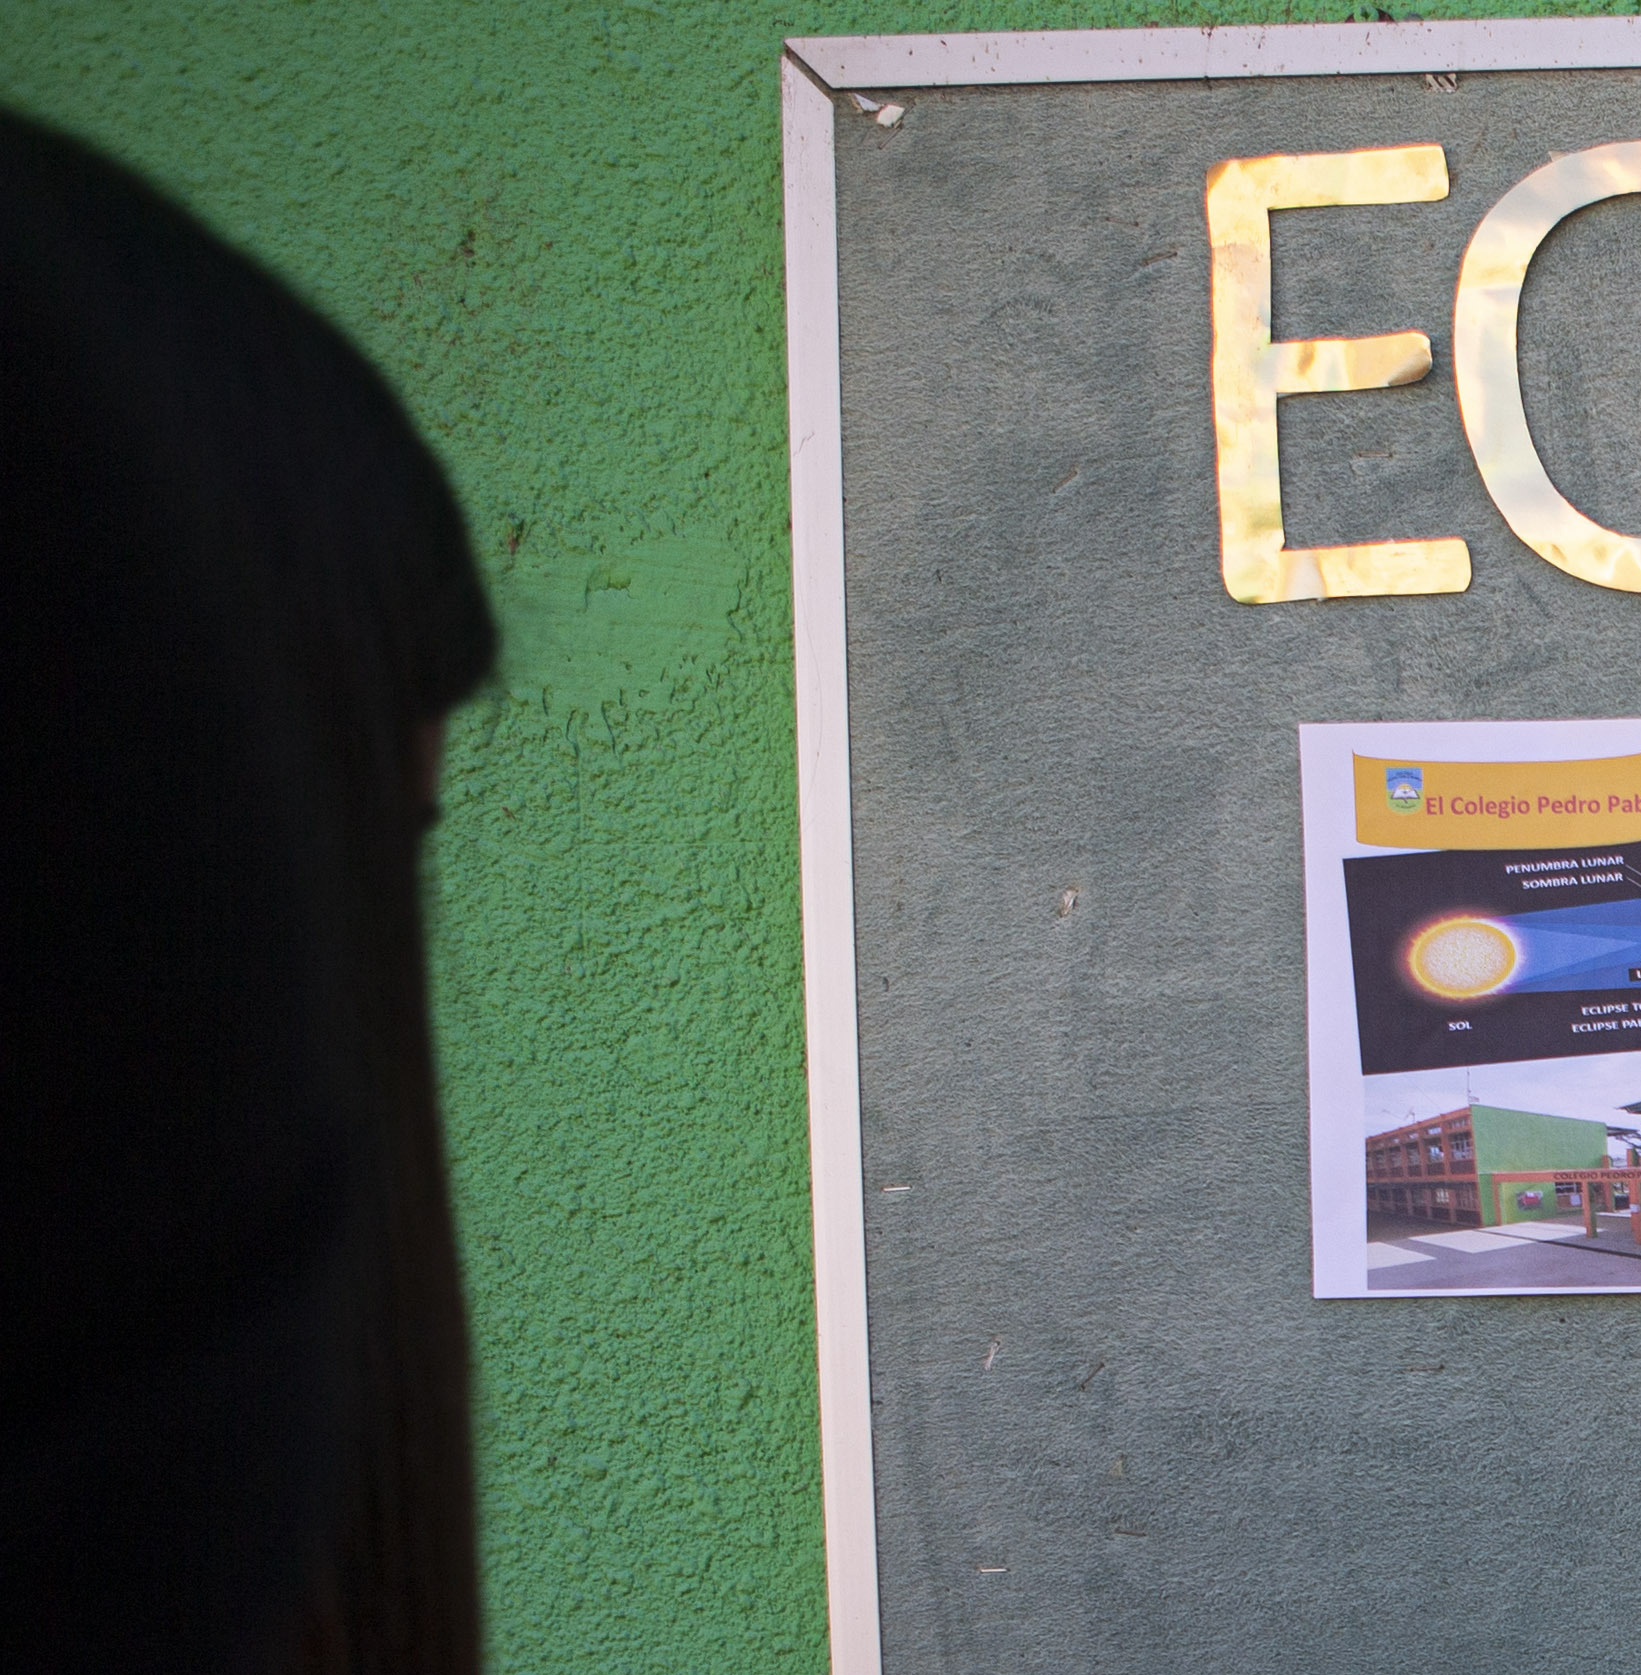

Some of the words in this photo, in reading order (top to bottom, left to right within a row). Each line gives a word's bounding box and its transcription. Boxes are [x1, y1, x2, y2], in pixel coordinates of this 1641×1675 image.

[1425, 796, 1444, 816] El
[1450, 796, 1531, 819] Colegio
[1537, 795, 1601, 815] Pedro
[1504, 859, 1579, 875] PENUMBRA
[1581, 855, 1625, 869] LUNAR
[1522, 876, 1578, 890] SOMBRA
[1580, 872, 1624, 886] LUNAR
[1581, 1003, 1629, 1016] ECLIPSE
[1448, 1020, 1473, 1031] SOL
[1571, 1020, 1619, 1033] ECLIPSE
